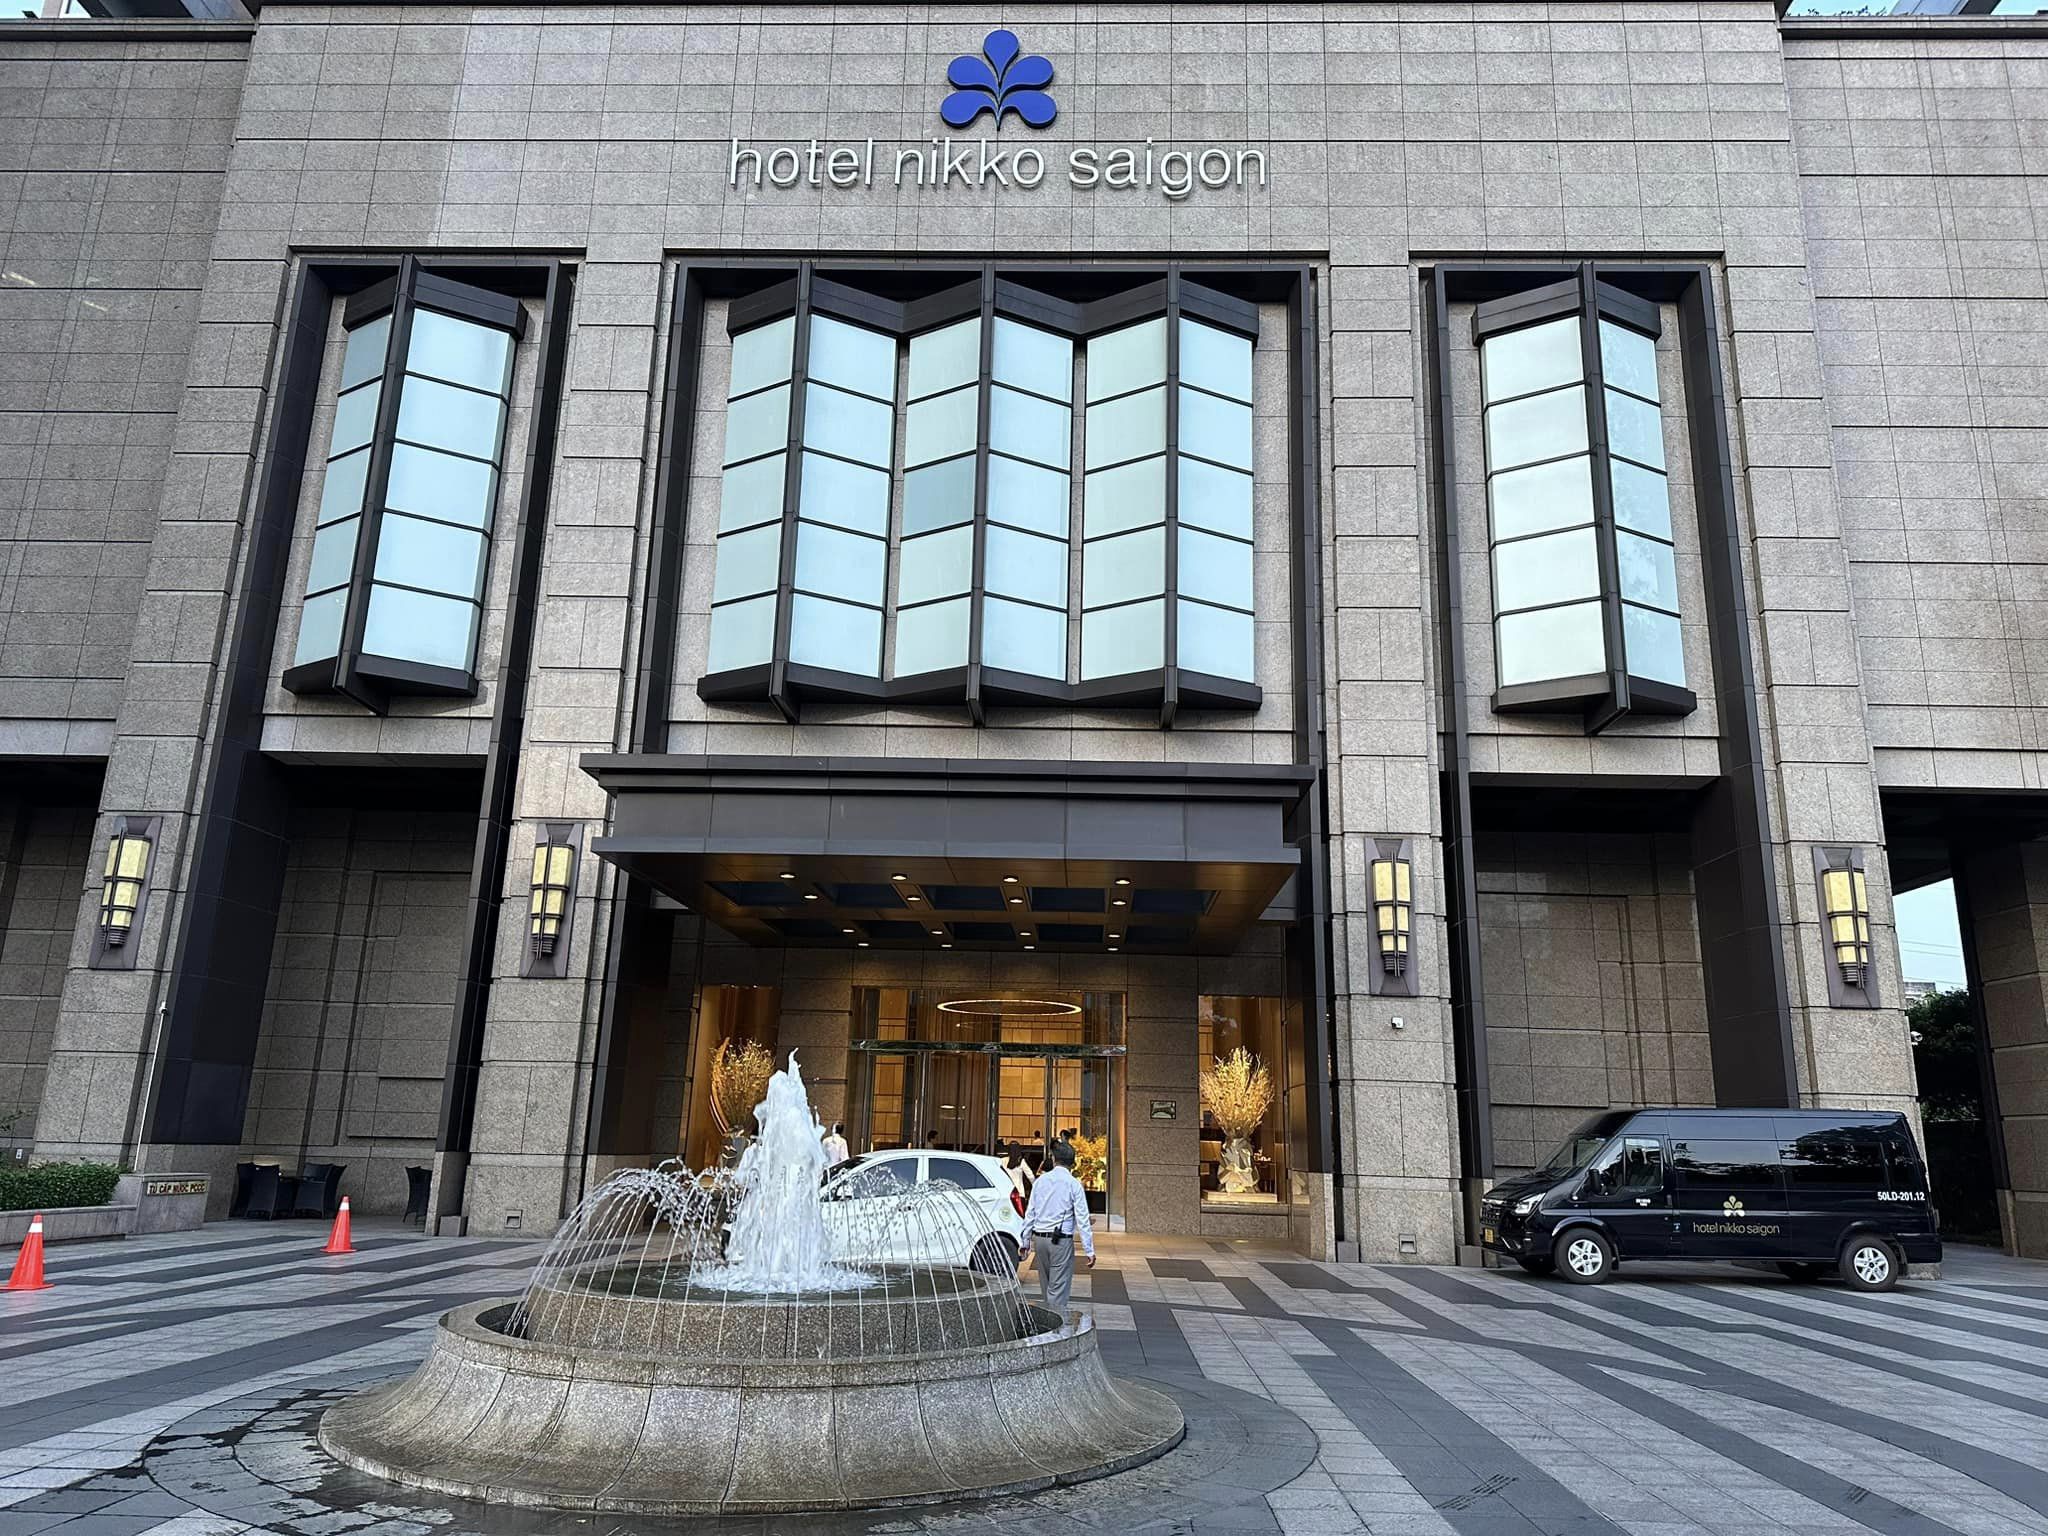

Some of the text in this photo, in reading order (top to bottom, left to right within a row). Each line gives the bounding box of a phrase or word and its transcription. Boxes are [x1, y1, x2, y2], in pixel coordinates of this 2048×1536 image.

[730, 136, 1266, 197] hotel nikko saigon
[1877, 1191, 1926, 1201] 50LD-201.12
[1693, 1222, 1780, 1236] hotel nikko saigon
